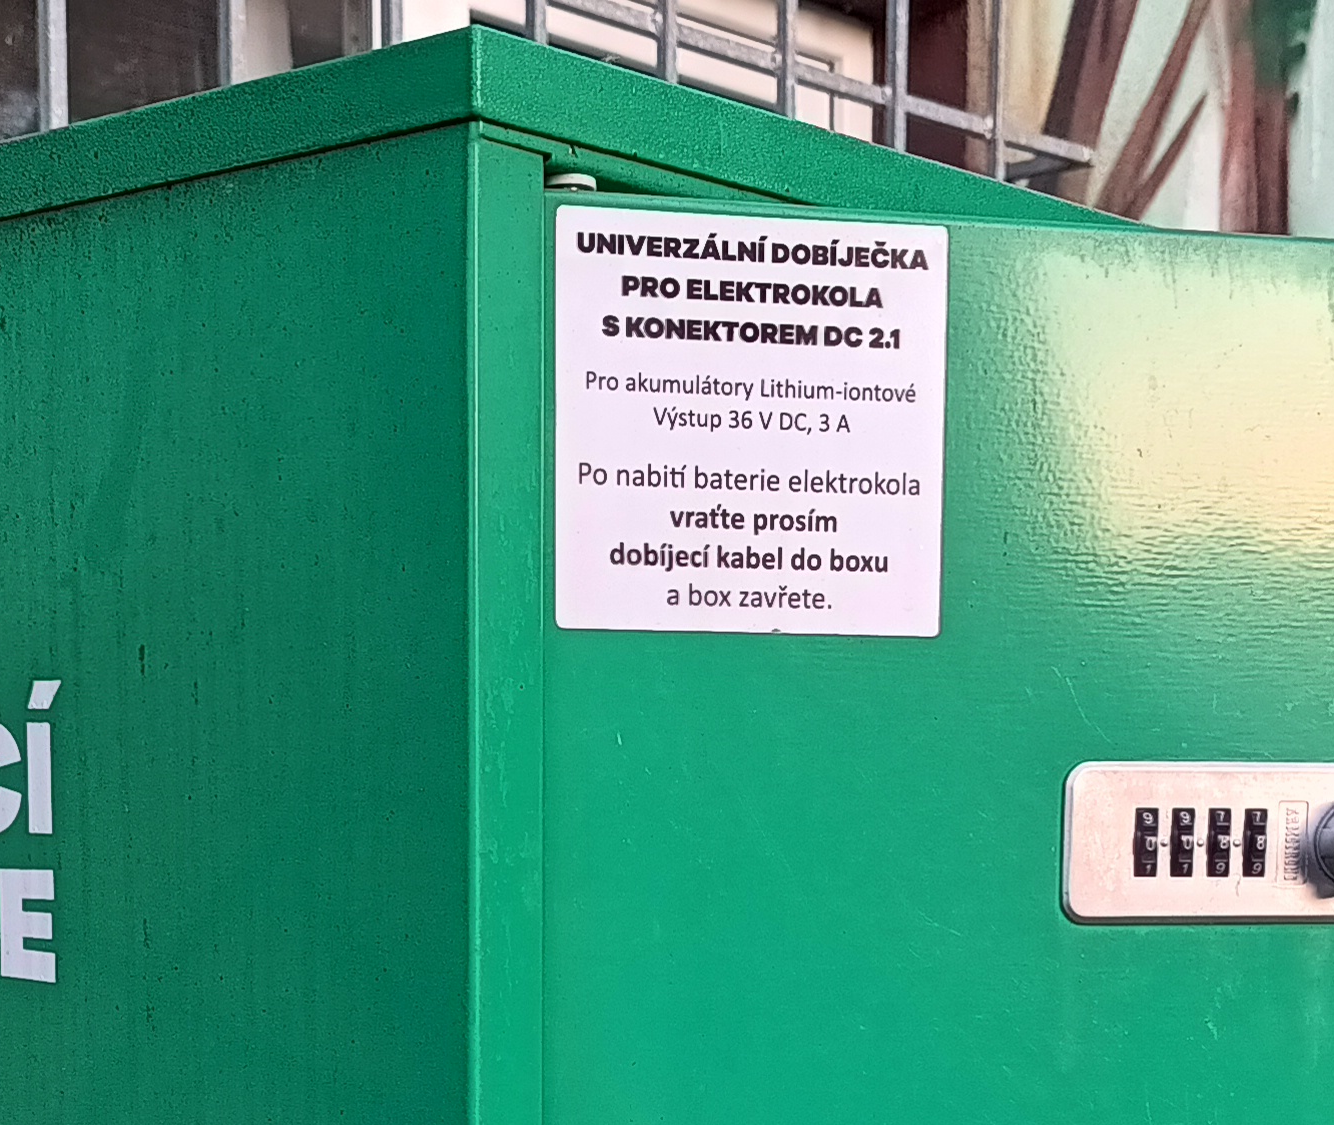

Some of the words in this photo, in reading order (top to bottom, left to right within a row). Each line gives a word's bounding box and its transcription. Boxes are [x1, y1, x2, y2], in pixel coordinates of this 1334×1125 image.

[577, 231, 768, 263] UNIVERZÁLNÍ
[771, 238, 929, 271] DOBÍJEČKA
[621, 275, 681, 299] PRO
[686, 278, 884, 309] ELEKTROKOLA
[601, 314, 620, 337] S
[625, 316, 819, 346] KONEKTOREM
[823, 325, 863, 348] DC
[868, 327, 901, 350] 2.1
[586, 370, 619, 391] Pro
[625, 372, 754, 402] akumulátory
[760, 378, 916, 403] Lithium-iontové
[653, 406, 722, 433] Výstup
[728, 410, 753, 430] 36
[758, 411, 773, 431] V
[779, 412, 812, 436] DC,
[818, 413, 830, 433] 3
[836, 414, 851, 433] A
[578, 462, 608, 486] Po
[616, 463, 687, 489] nabití
[694, 465, 780, 492] baterie
[788, 469, 920, 496] elektrokola
[669, 503, 745, 530] vraťte
[753, 508, 838, 536] prosím
[609, 541, 711, 573] dobíjecí
[716, 544, 783, 570] kabel
[790, 547, 822, 571] do
[829, 547, 888, 573] boxu
[666, 588, 679, 606] a
[688, 582, 731, 607] box
[738, 585, 832, 610] zavřete.
